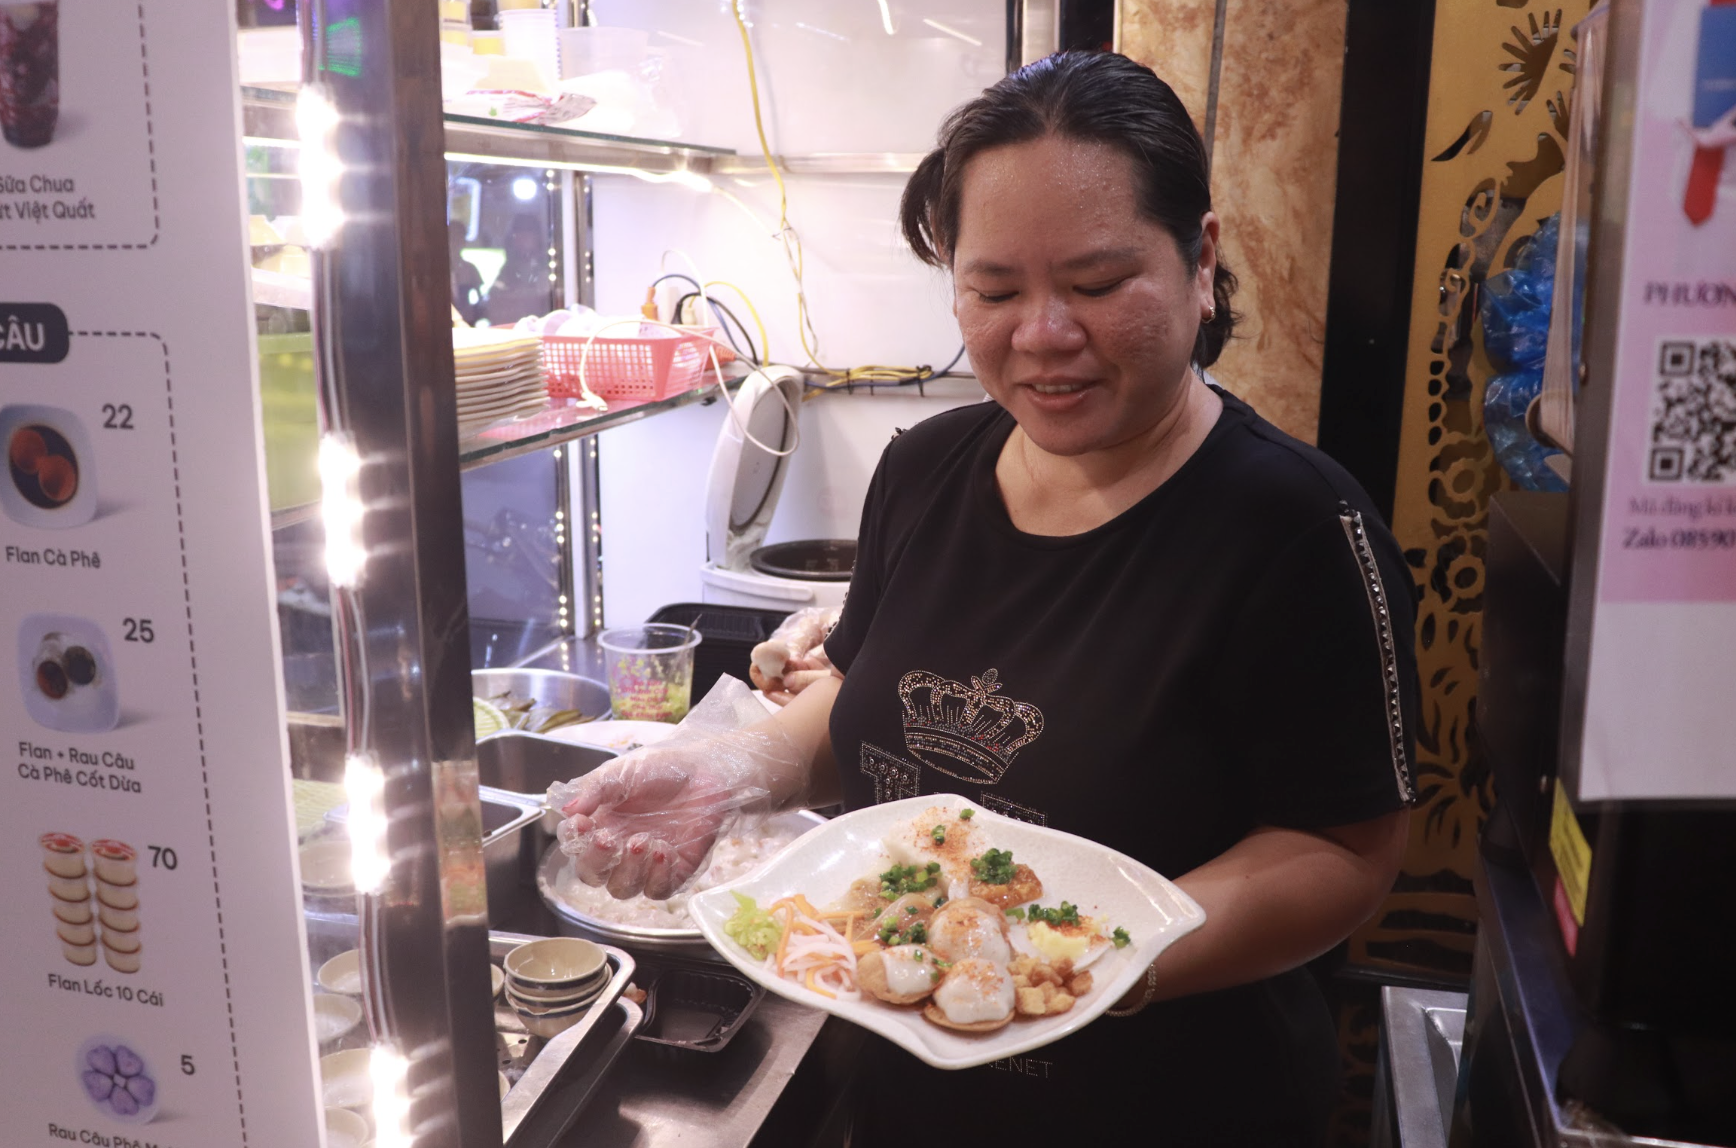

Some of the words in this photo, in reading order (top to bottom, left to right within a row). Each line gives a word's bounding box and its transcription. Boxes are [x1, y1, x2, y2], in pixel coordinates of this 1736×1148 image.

[29, 174, 75, 194] Chua
[14, 200, 49, 224] Việt
[52, 197, 96, 219] Quất
[0, 314, 45, 351] ÂU
[101, 403, 134, 430] 22
[5, 546, 41, 565] Flan
[43, 548, 67, 567] Cà
[70, 550, 101, 568] Phê
[122, 617, 155, 643] 25
[18, 742, 52, 760] Flan
[57, 751, 64, 759] +
[68, 748, 98, 766] Rau
[102, 752, 135, 771] Câu
[18, 763, 40, 780] Cà
[43, 767, 72, 785] Phê
[76, 770, 105, 789] Cốt
[109, 775, 142, 793] Dừa
[147, 845, 178, 871] 70
[48, 973, 81, 992] Flan
[84, 979, 113, 998] Lốc
[116, 986, 133, 1001] 10
[137, 989, 164, 1007] Cái
[180, 1054, 195, 1076] 5
[48, 1123, 76, 1141] Rau
[80, 1129, 110, 1147] Câu
